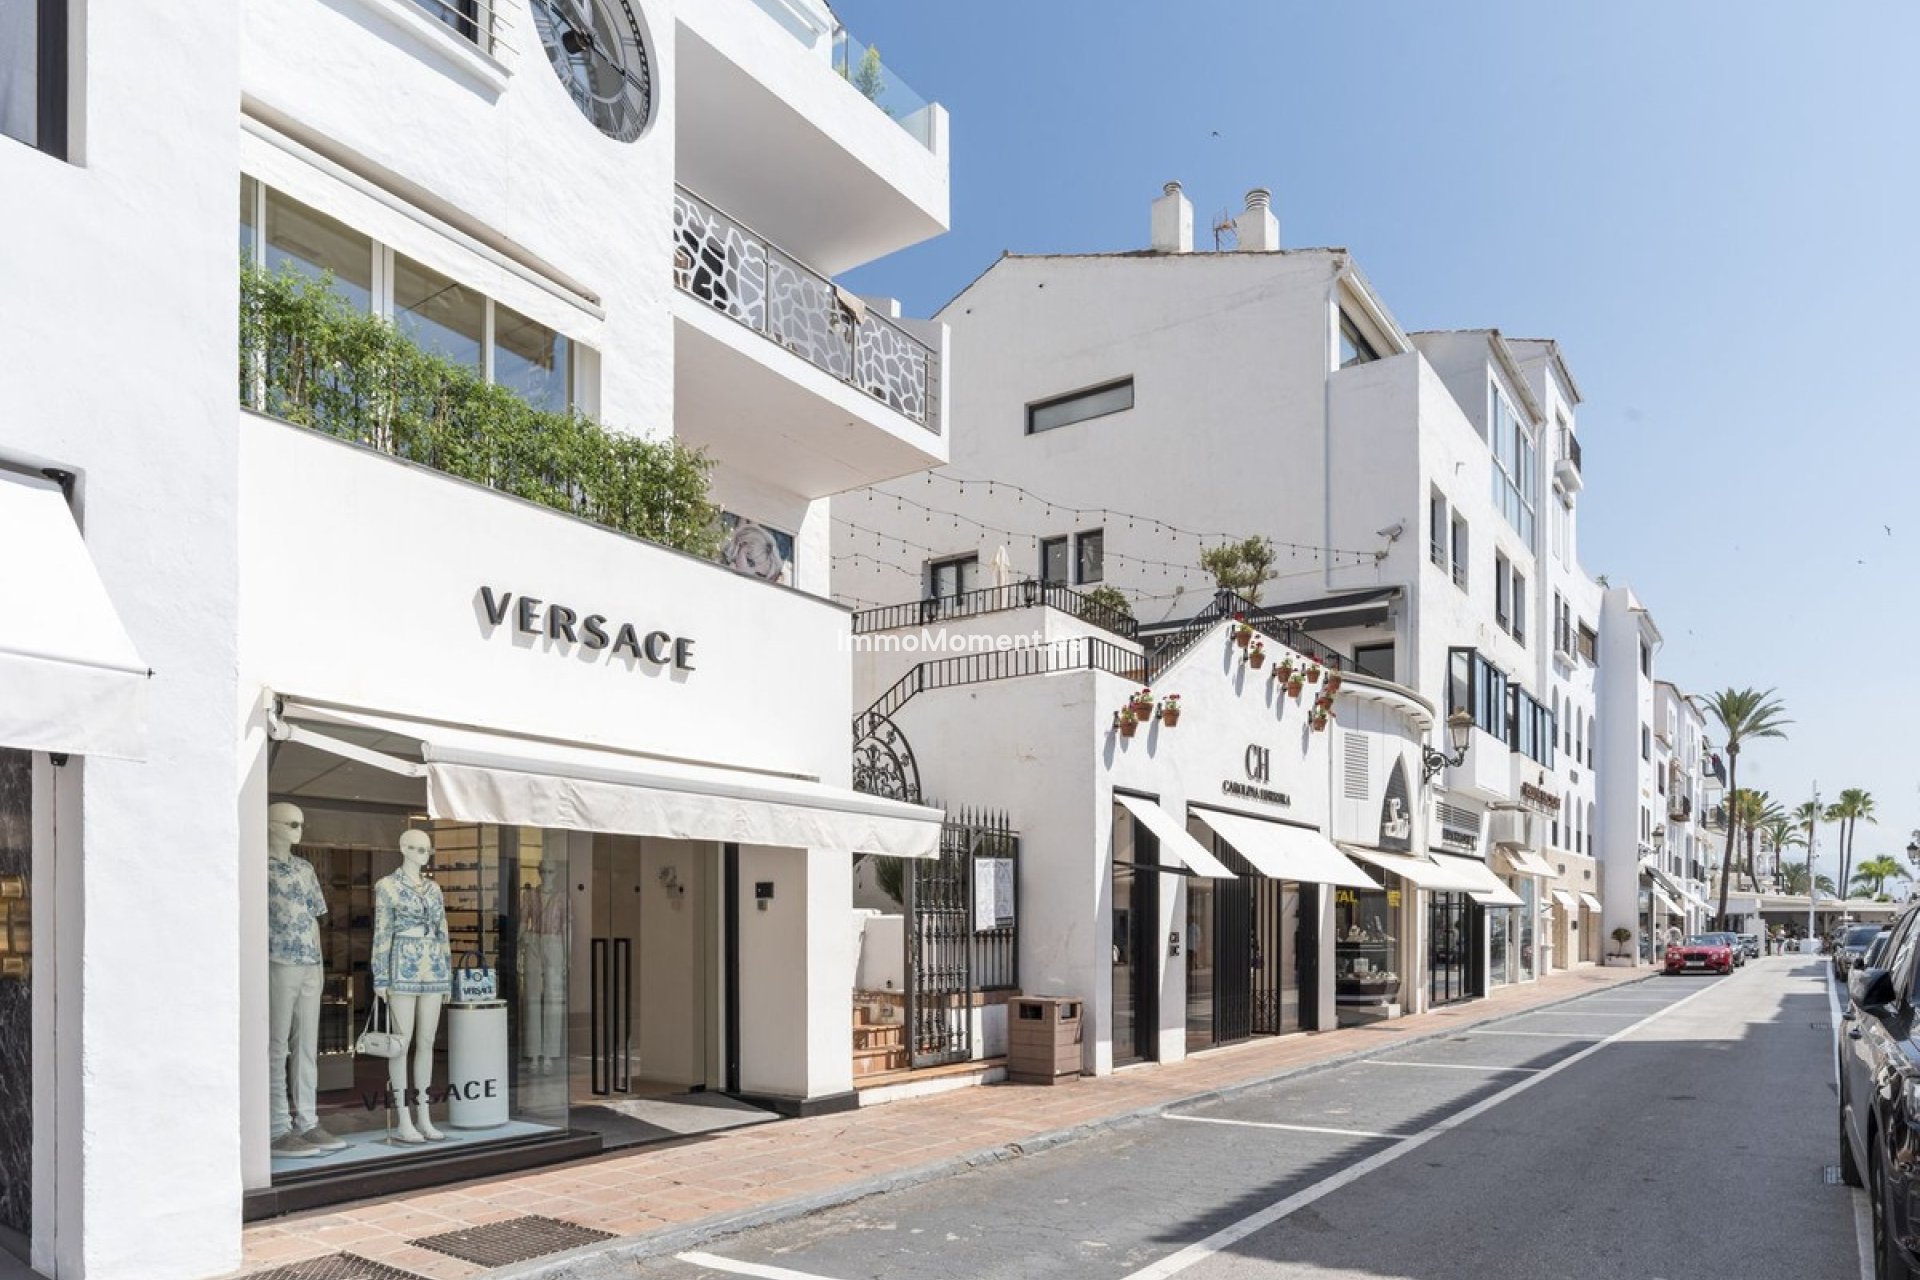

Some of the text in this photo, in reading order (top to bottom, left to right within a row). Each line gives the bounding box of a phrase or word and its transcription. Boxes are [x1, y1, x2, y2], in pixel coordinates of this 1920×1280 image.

[479, 585, 697, 672] VERSACE
[1244, 743, 1270, 785] CH
[360, 1078, 498, 1112] VERSACE
